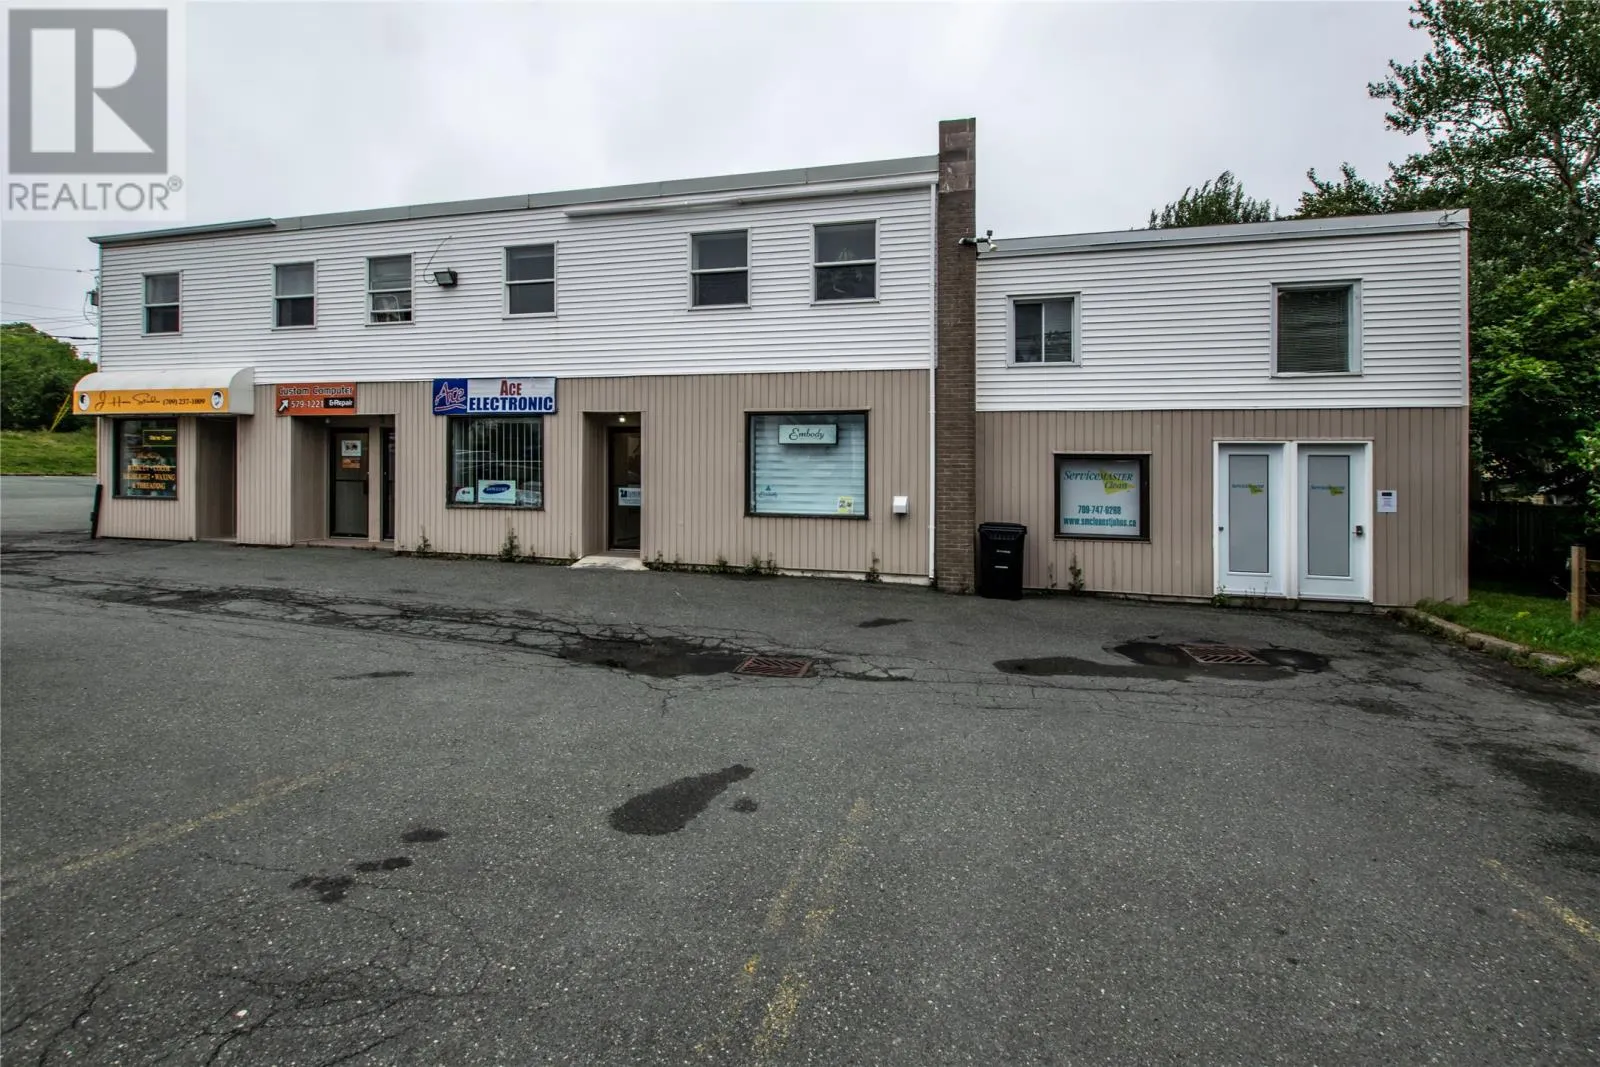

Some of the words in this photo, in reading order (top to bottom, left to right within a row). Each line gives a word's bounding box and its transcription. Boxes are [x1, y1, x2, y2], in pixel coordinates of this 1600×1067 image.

[279, 387, 310, 396] Custom
[312, 386, 353, 396] Computer
[435, 381, 466, 406] Ace
[469, 397, 553, 411] ELECTRONIC
[789, 427, 825, 441] Embody
